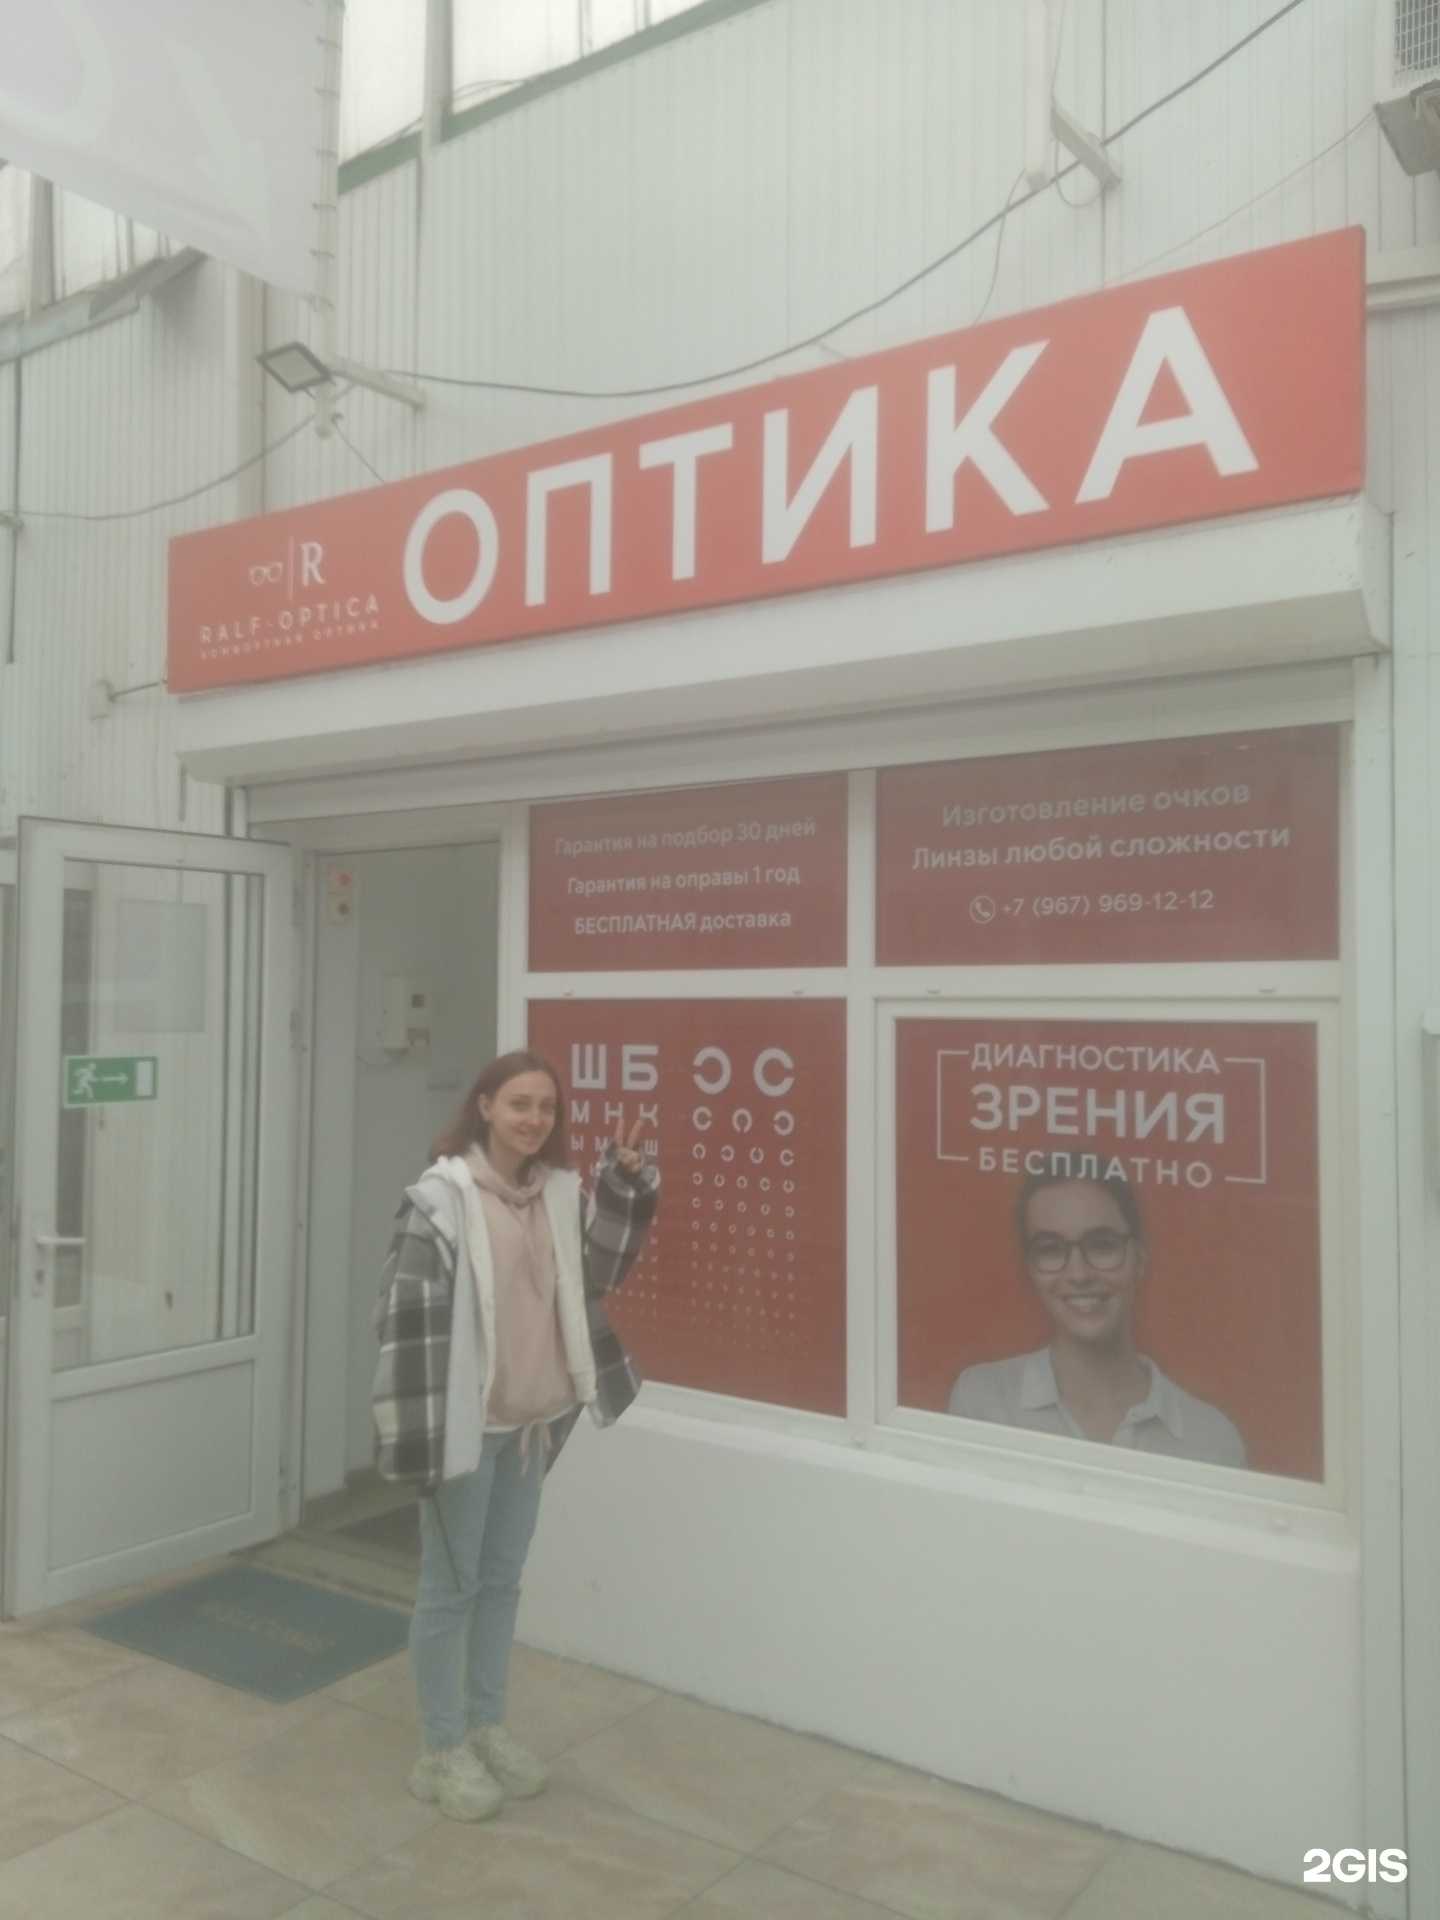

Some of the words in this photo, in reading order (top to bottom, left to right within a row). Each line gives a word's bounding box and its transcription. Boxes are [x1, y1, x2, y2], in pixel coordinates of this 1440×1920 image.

[403, 305, 1260, 625] ОПТИКА
[942, 795, 1146, 827] Изготовление
[1153, 784, 1251, 810] очков
[555, 835, 634, 857] Гарантия
[637, 832, 658, 849] на
[662, 825, 734, 847] подбор
[737, 822, 761, 842] 30
[765, 815, 817, 840] дней
[912, 847, 998, 871] Линзы
[1004, 836, 1103, 864] любой
[1109, 826, 1291, 858] сложности
[567, 876, 647, 898] Гарантия
[651, 873, 672, 890] на
[675, 872, 749, 890] оправы
[752, 866, 761, 884] 1
[765, 866, 802, 884] год
[1002, 898, 1026, 917] +7
[1032, 896, 1090, 917] (967)
[1098, 888, 1216, 913] 969-12-12
[574, 912, 697, 935] БЕСПЛАТНАЯ
[700, 912, 792, 931] доставка
[971, 1042, 1220, 1074] ДИАГНОСТИКА
[970, 1083, 1226, 1145] ЗРЕНИЯ
[979, 1147, 1213, 1188] БЕСПЛАТНО
